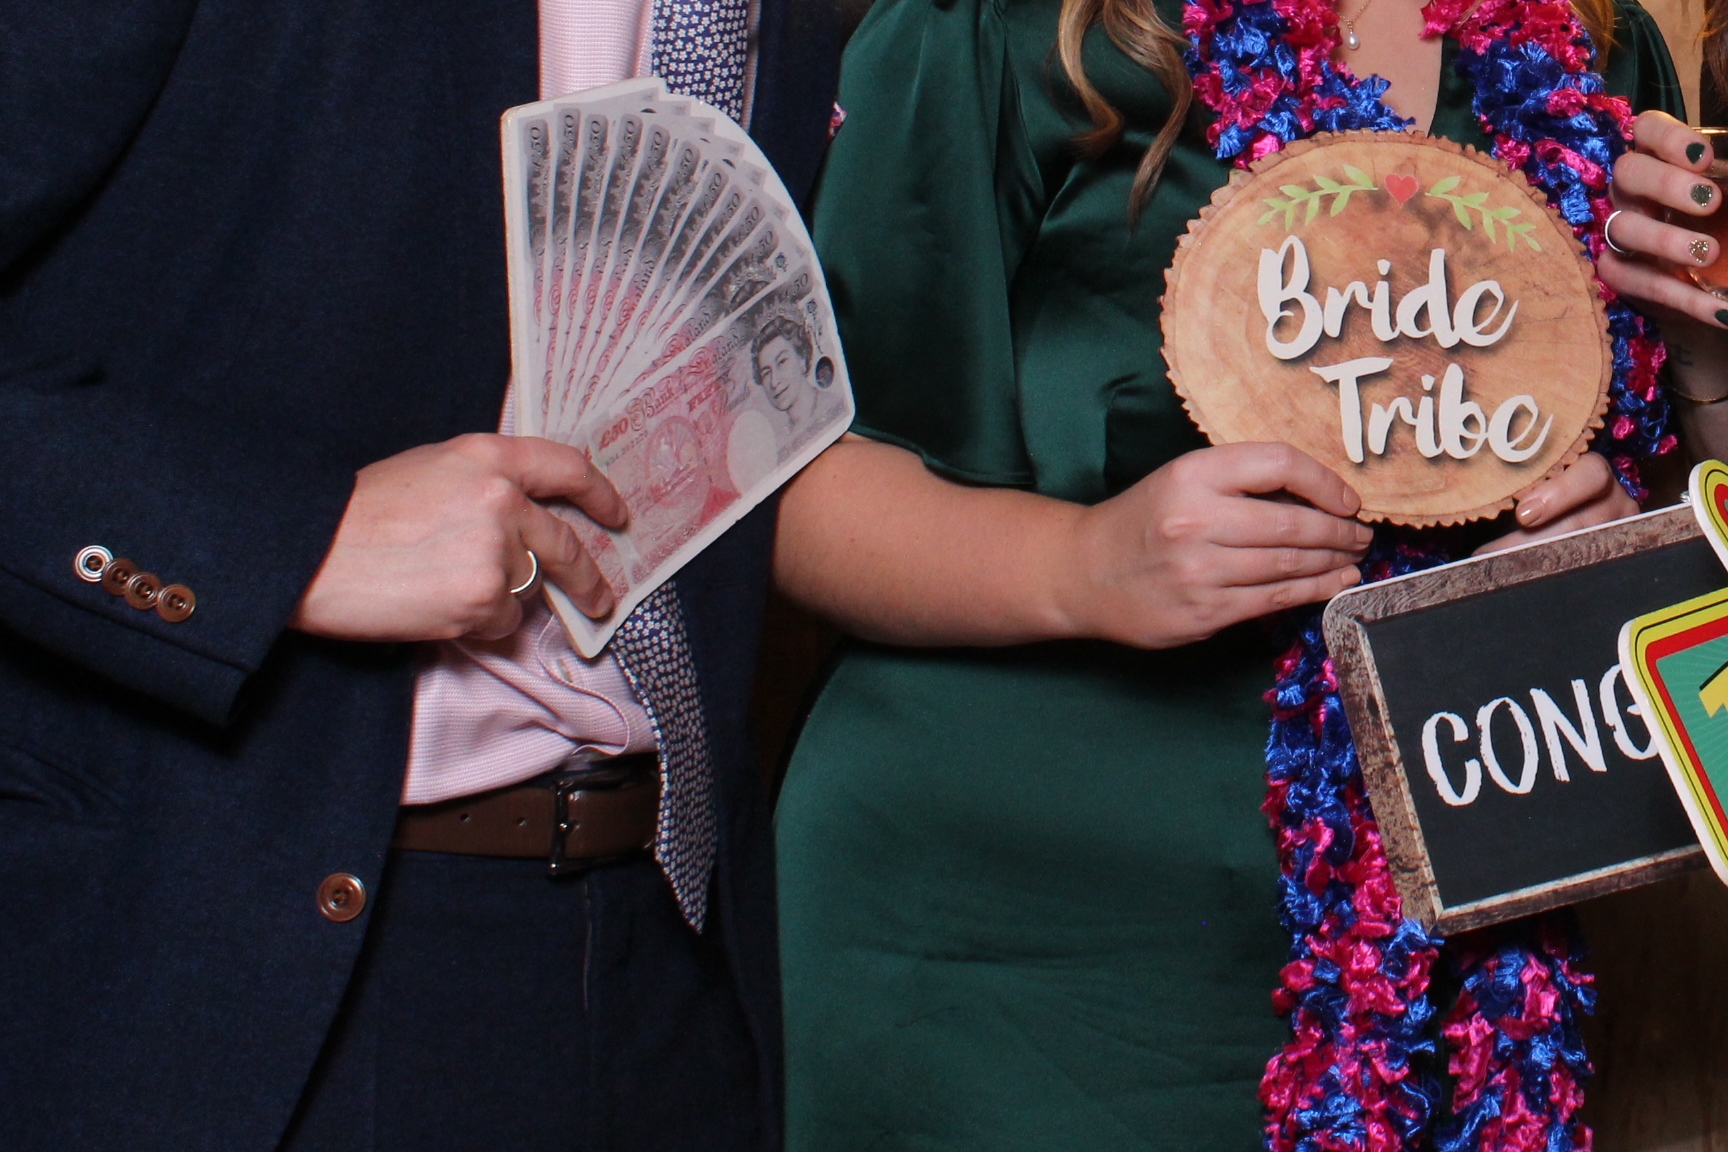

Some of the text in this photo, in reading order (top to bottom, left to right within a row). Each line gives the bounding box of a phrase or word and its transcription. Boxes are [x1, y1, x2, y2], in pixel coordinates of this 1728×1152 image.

[1257, 234, 1520, 360] Bride
[599, 418, 629, 451] £50
[1309, 356, 1554, 464] Tribe
[1421, 663, 1660, 806] CONG
